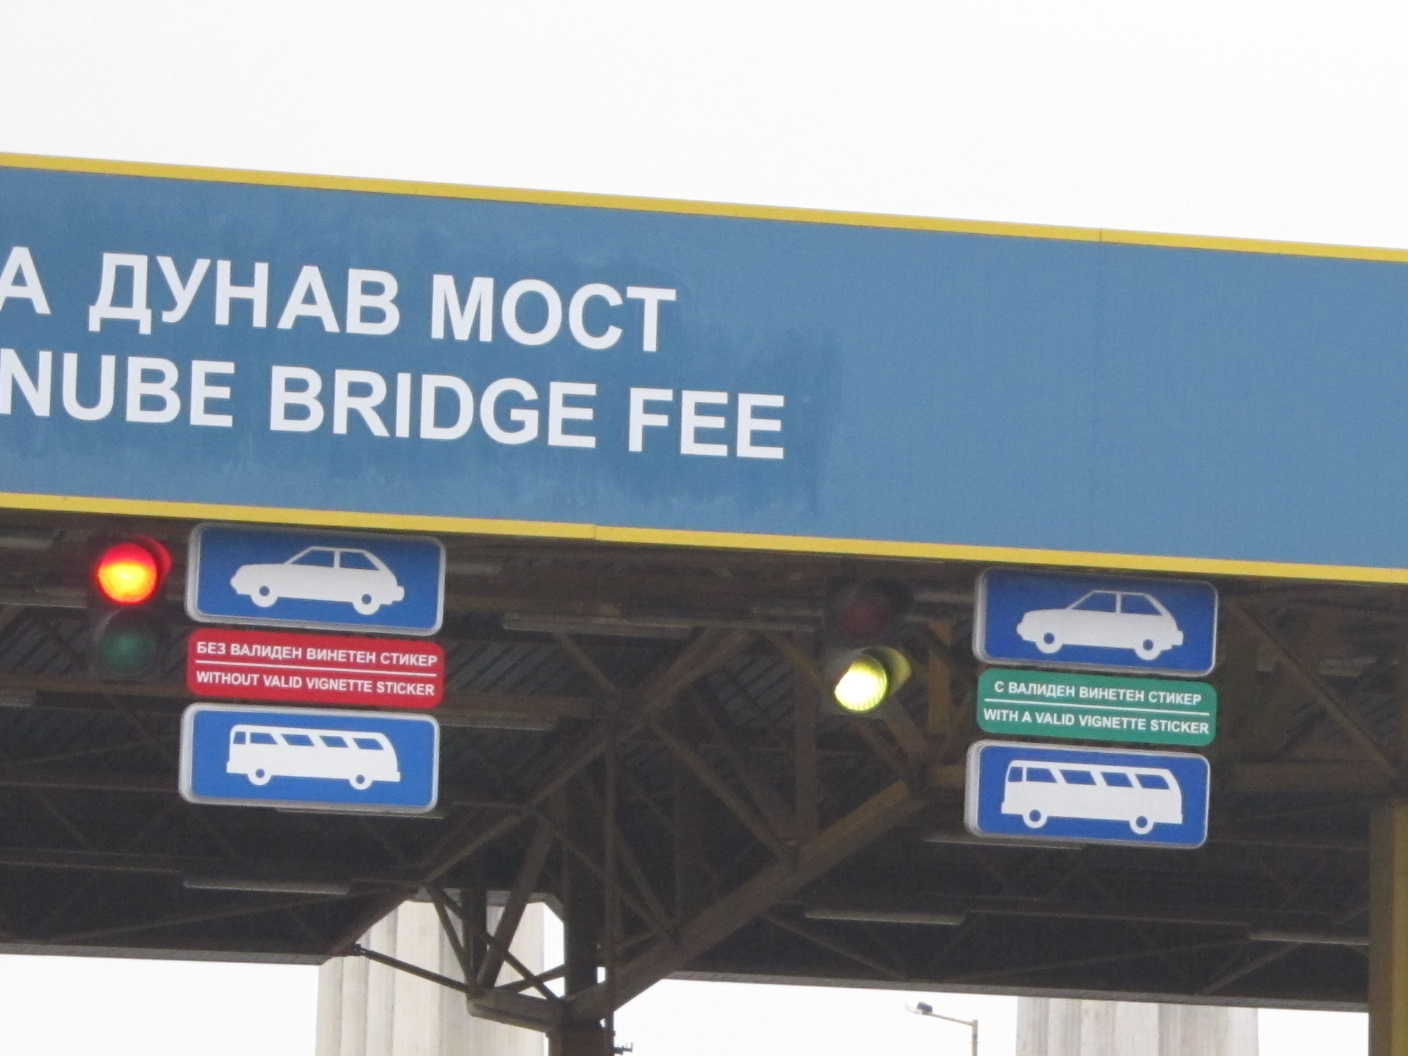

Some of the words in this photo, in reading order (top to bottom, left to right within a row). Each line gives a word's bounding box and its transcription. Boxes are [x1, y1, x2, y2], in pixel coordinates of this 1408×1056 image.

[88, 252, 400, 336] ДУНАВ
[430, 274, 677, 353] МОСТ
[0, 348, 235, 427] NUBE
[269, 365, 597, 449] BRIDGE
[628, 388, 786, 460] FEE
[197, 641, 226, 655] БЕЗ
[231, 643, 302, 661] ВАЛИДЕН
[307, 648, 376, 664] ВИНЕТЕН
[380, 652, 437, 667] СТИКЕР
[196, 671, 259, 686] WITHOUT
[263, 674, 302, 688] VALID
[306, 677, 373, 693] VIGNETTE
[376, 681, 435, 696] STICKER
[994, 681, 1004, 692] С
[1008, 682, 1076, 699] ВАЛИДЕН
[1080, 686, 1145, 702] ВИНЕТЕН
[1149, 691, 1202, 706] СТИКЕР
[983, 708, 1018, 722] WITH
[1021, 711, 1032, 723] A
[1035, 713, 1075, 726] VALID
[1079, 715, 1147, 731] VIGNETTE
[1150, 719, 1209, 735] STICKER
